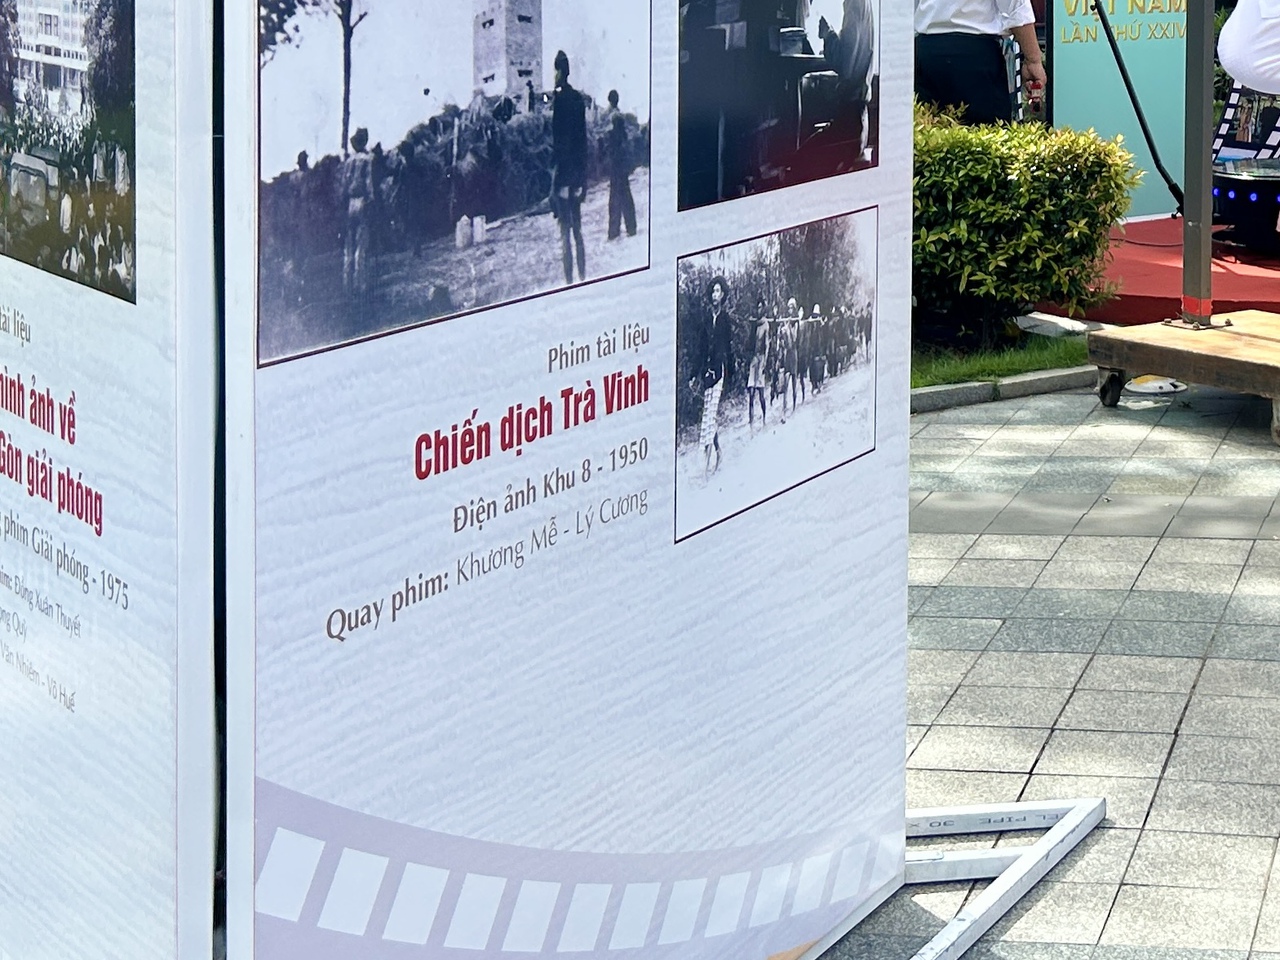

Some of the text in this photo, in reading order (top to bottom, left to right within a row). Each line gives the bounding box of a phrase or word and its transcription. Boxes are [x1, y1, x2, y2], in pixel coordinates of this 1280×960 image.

[1061, 20, 1098, 44] LẦN
[1110, 19, 1143, 41] HỨ
[14, 308, 31, 348] liệu
[548, 323, 650, 373] Phim tài liệu
[30, 374, 55, 436] ảnh
[59, 390, 76, 445] về
[415, 365, 649, 480] Chiến dịch Trà Vinh
[27, 448, 53, 503] giải
[57, 466, 103, 537] phóng
[454, 497, 498, 533] Điện
[504, 478, 537, 514] ảnh
[543, 467, 576, 498] Khu
[581, 459, 592, 483] 8
[609, 437, 649, 473] 1950
[4, 509, 29, 547] phim
[32, 526, 53, 562] Giải
[56, 542, 89, 594] phóng
[100, 569, 129, 610] 1975
[326, 598, 384, 642] Quay
[391, 571, 449, 622] phim:
[456, 540, 525, 585] Khương
[575, 505, 595, 540] Lý
[599, 489, 649, 524] Cương
